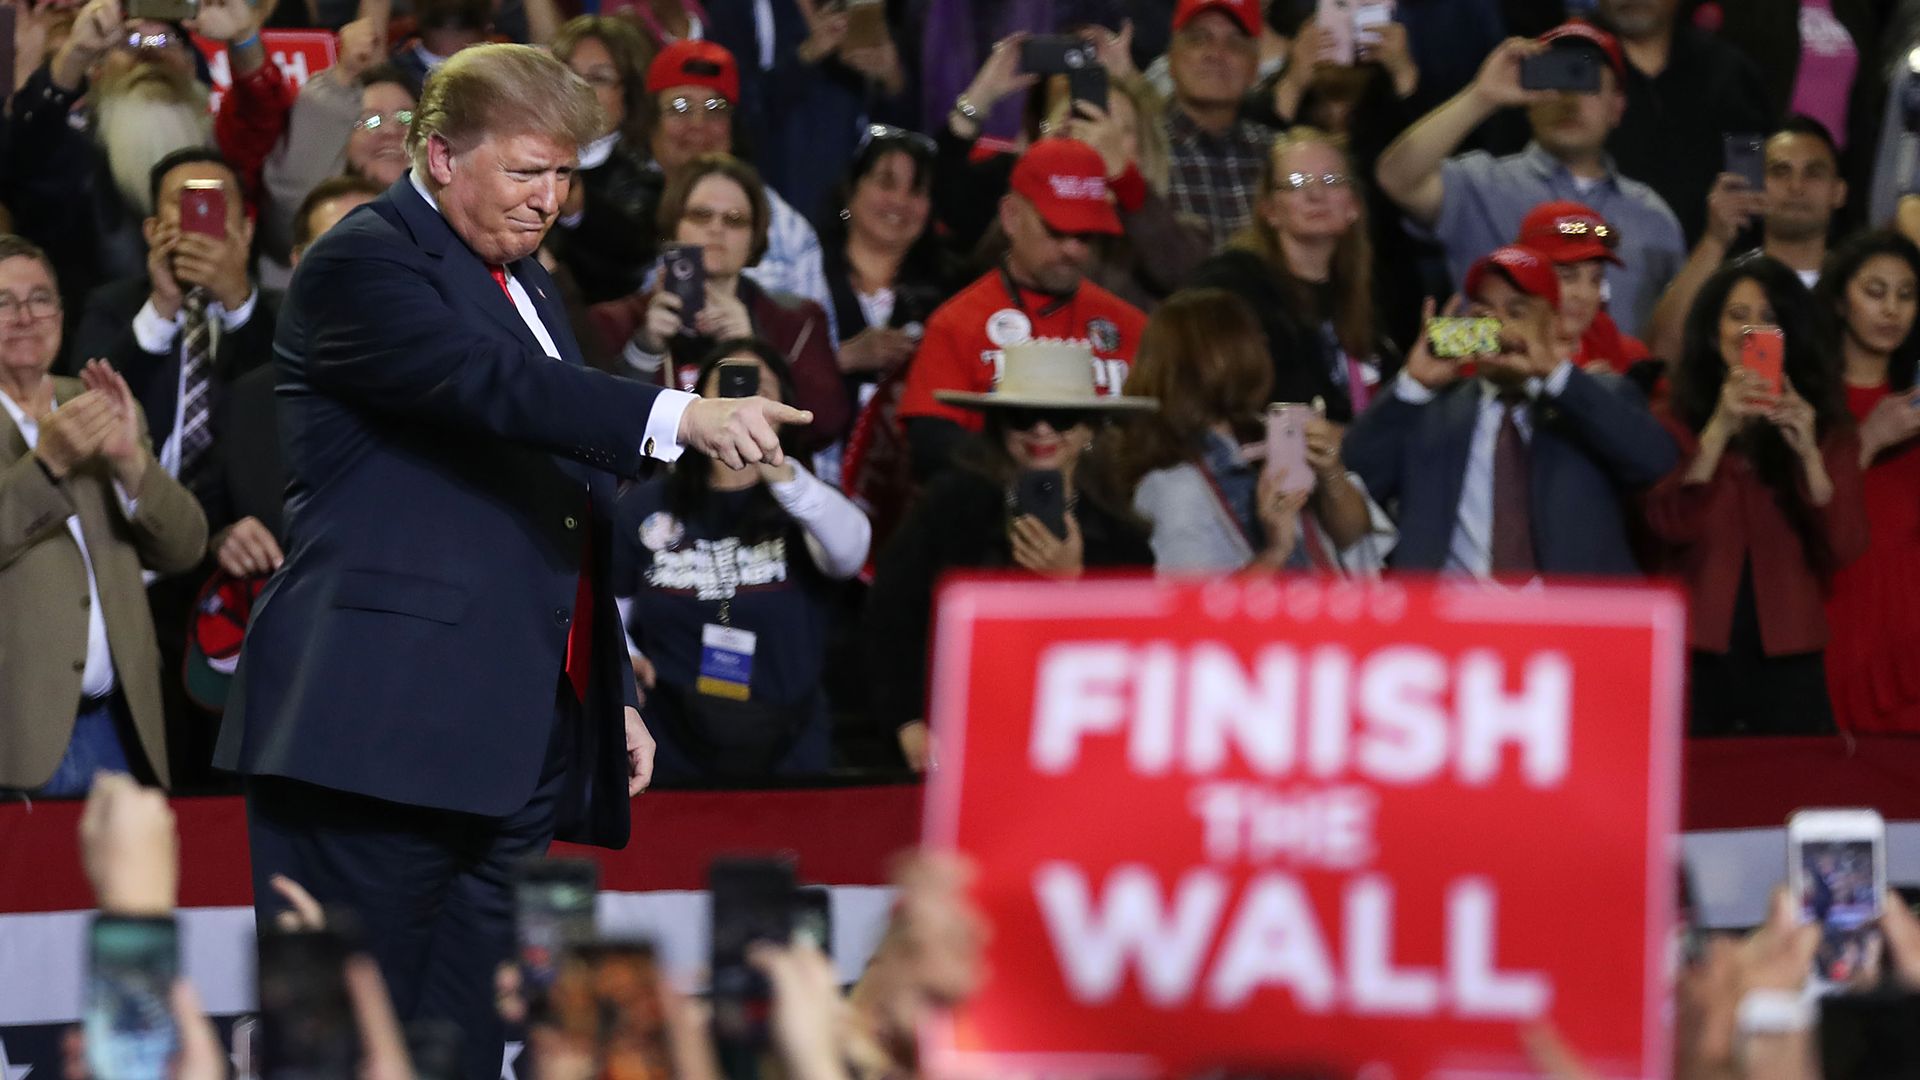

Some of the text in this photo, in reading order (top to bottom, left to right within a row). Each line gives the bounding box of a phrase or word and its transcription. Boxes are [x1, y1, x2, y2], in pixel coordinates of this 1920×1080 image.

[1032, 643, 1571, 786] FINISH
[1195, 783, 1374, 867] THE
[1036, 863, 1550, 1018] WALL
